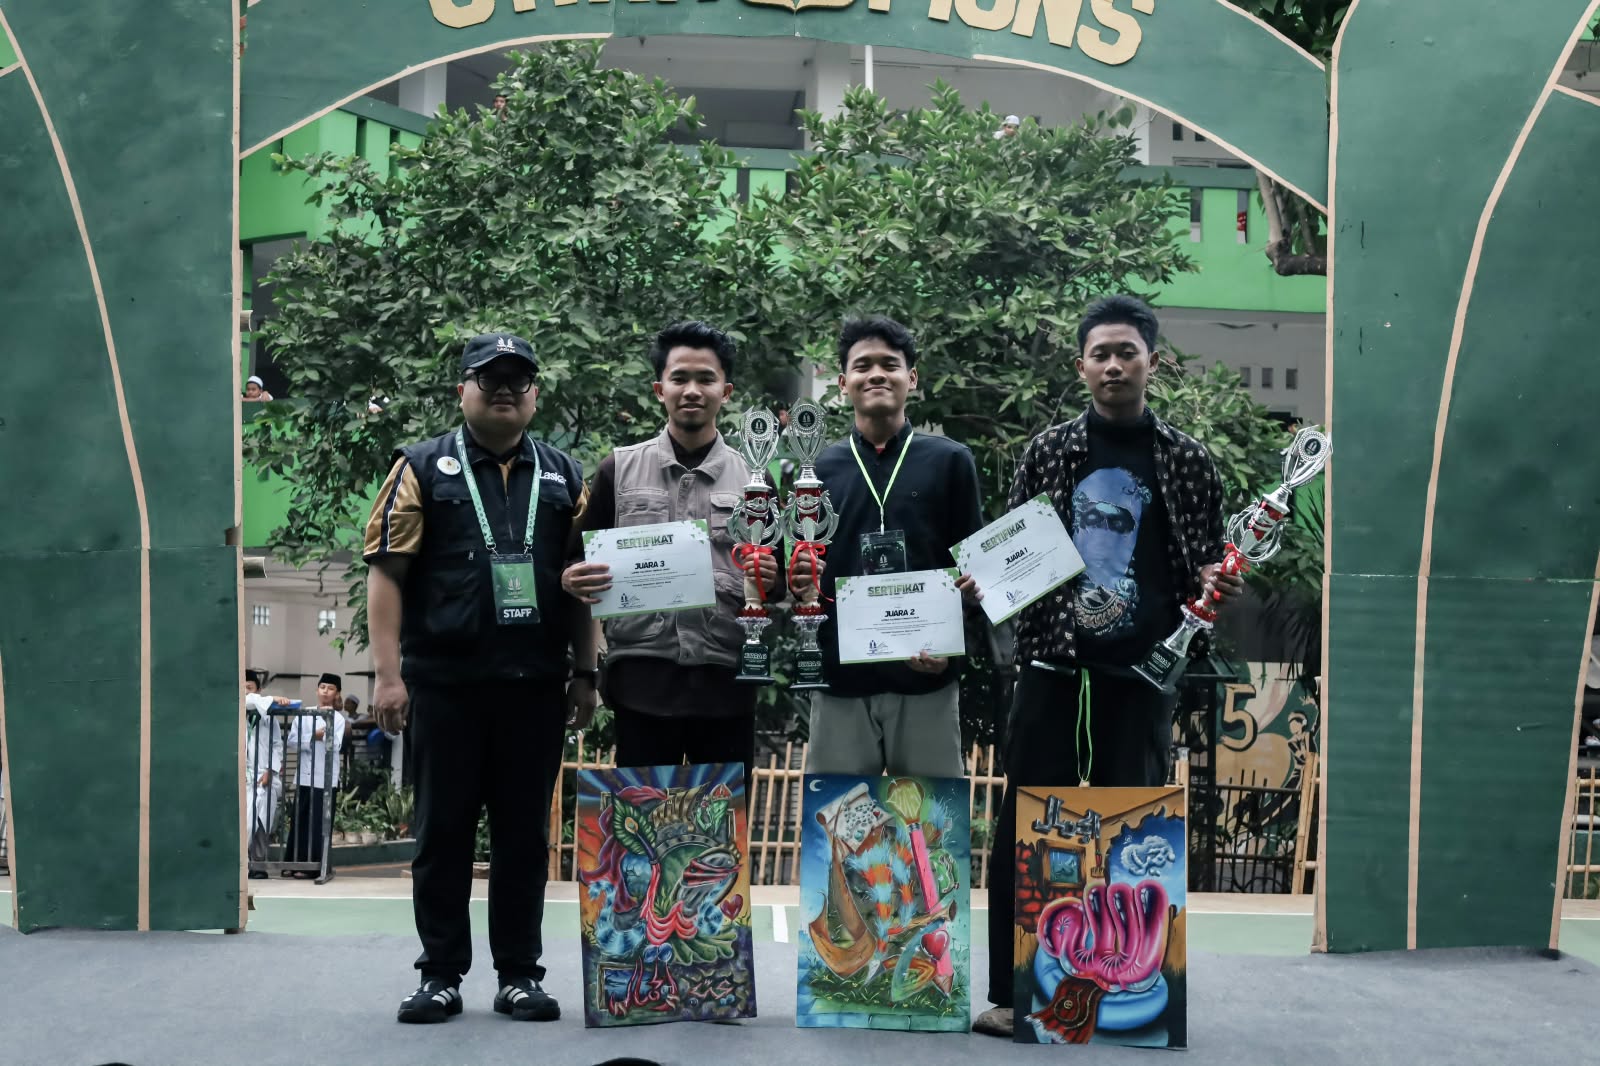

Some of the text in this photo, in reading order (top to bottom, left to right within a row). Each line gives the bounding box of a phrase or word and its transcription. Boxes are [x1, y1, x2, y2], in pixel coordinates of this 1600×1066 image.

[616, 534, 674, 549] SERTIFIKAT
[980, 519, 1027, 552] SERTIFIKAT
[1004, 550, 1025, 565] JUARA
[634, 561, 659, 570] JUARA
[868, 582, 925, 596] SERTIFIKAT
[503, 608, 532, 618] STAFF
[884, 609, 909, 617] JUARA
[1220, 683, 1258, 751] 5
